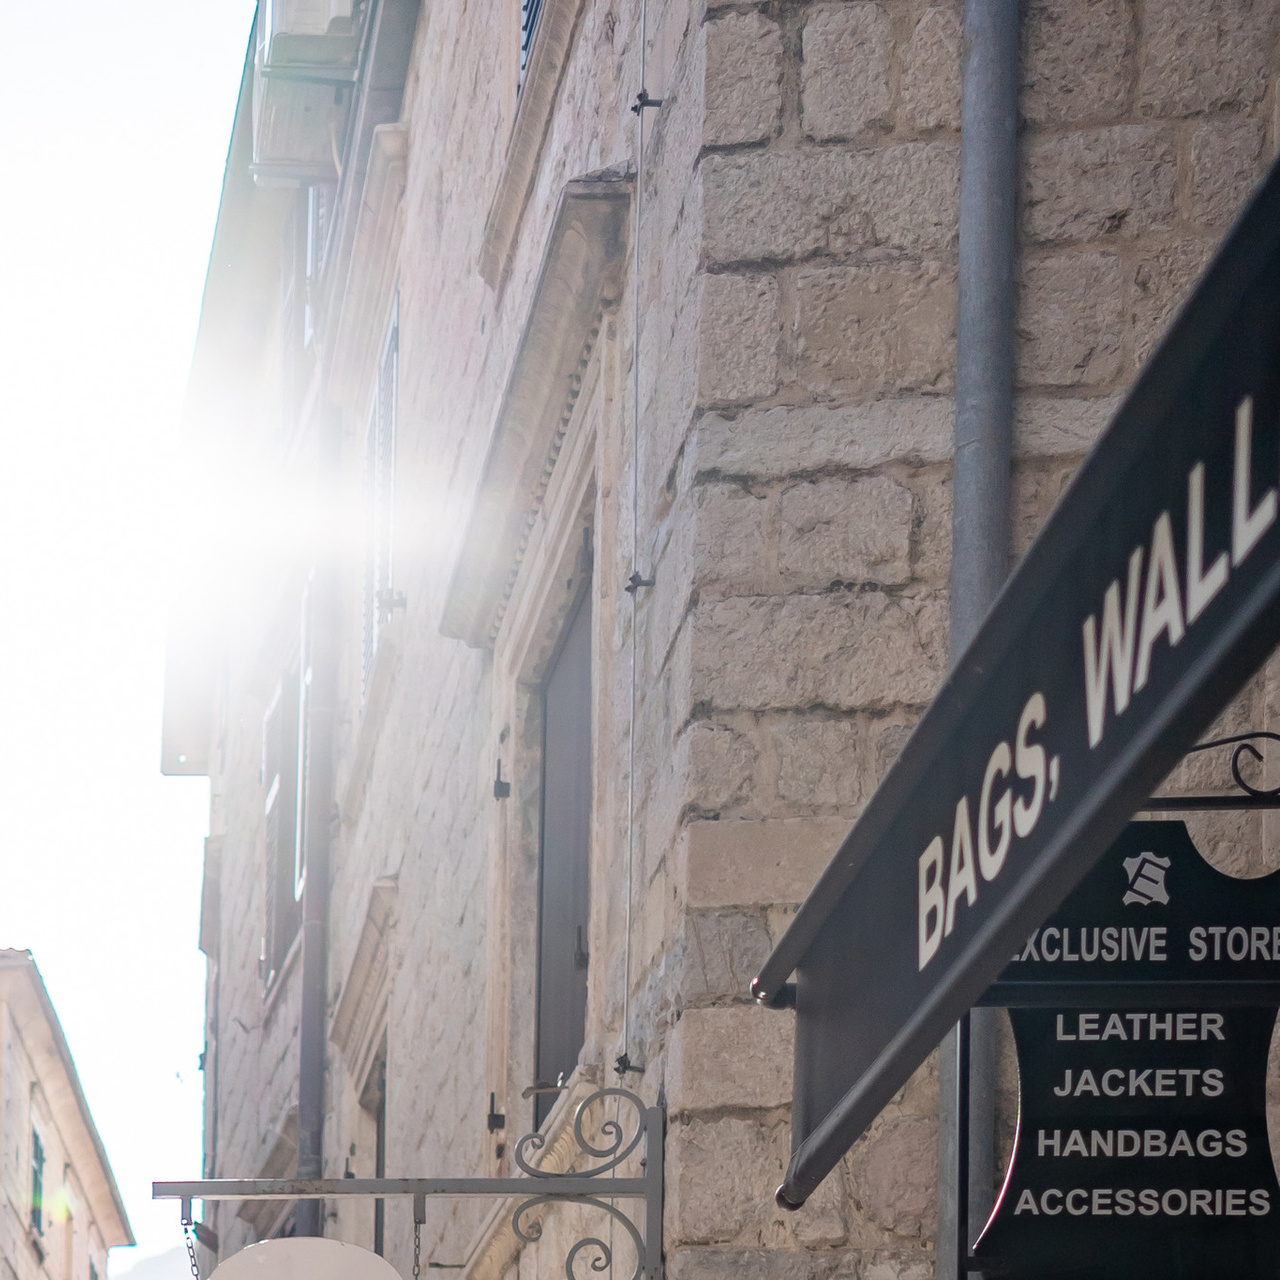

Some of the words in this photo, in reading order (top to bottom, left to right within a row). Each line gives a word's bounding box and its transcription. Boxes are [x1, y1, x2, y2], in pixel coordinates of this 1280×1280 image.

[918, 691, 1060, 972] BAGS,
[1082, 394, 1278, 750] WALL
[1009, 926, 1168, 962] XCLUSIVE
[1055, 1012, 1226, 1042] LEATHER
[1053, 1068, 1225, 1097] JACKETS
[1037, 1129, 1248, 1158] HANDBAGS
[1013, 1188, 1271, 1216] ACCESSORIES
